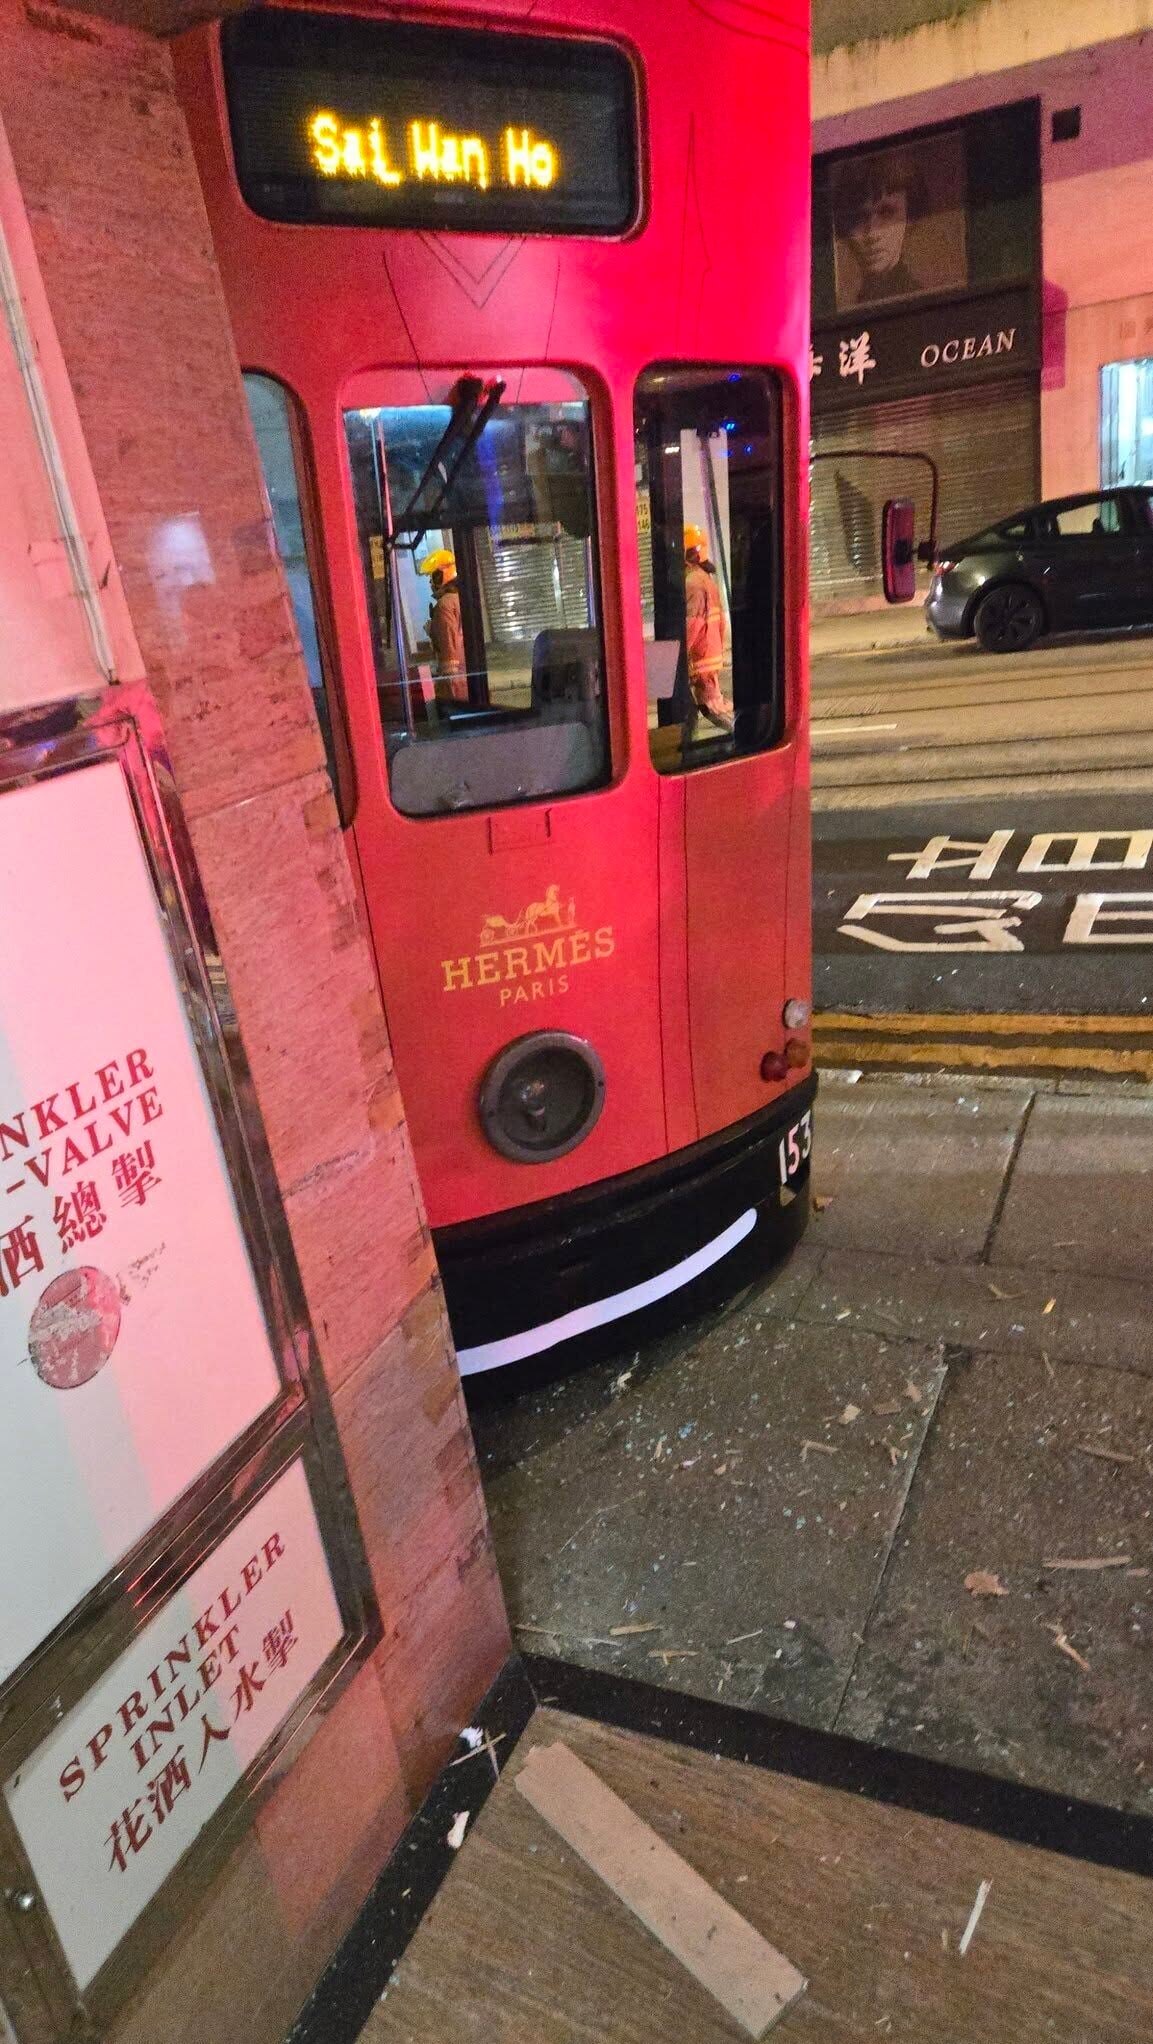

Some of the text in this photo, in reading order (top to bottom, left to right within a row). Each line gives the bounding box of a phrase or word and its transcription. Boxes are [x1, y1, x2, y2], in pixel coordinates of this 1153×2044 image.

[307, 108, 558, 190] Sai Wan Ho
[920, 328, 1017, 368] OCEAN
[499, 974, 571, 1008] PARIS
[0, 1048, 154, 1161] NKLER
[6, 1085, 164, 1194] -VALVE
[779, 1109, 812, 1185] 153
[59, 1532, 286, 1803] SPRINKLER
[129, 1624, 241, 1774] INLET
